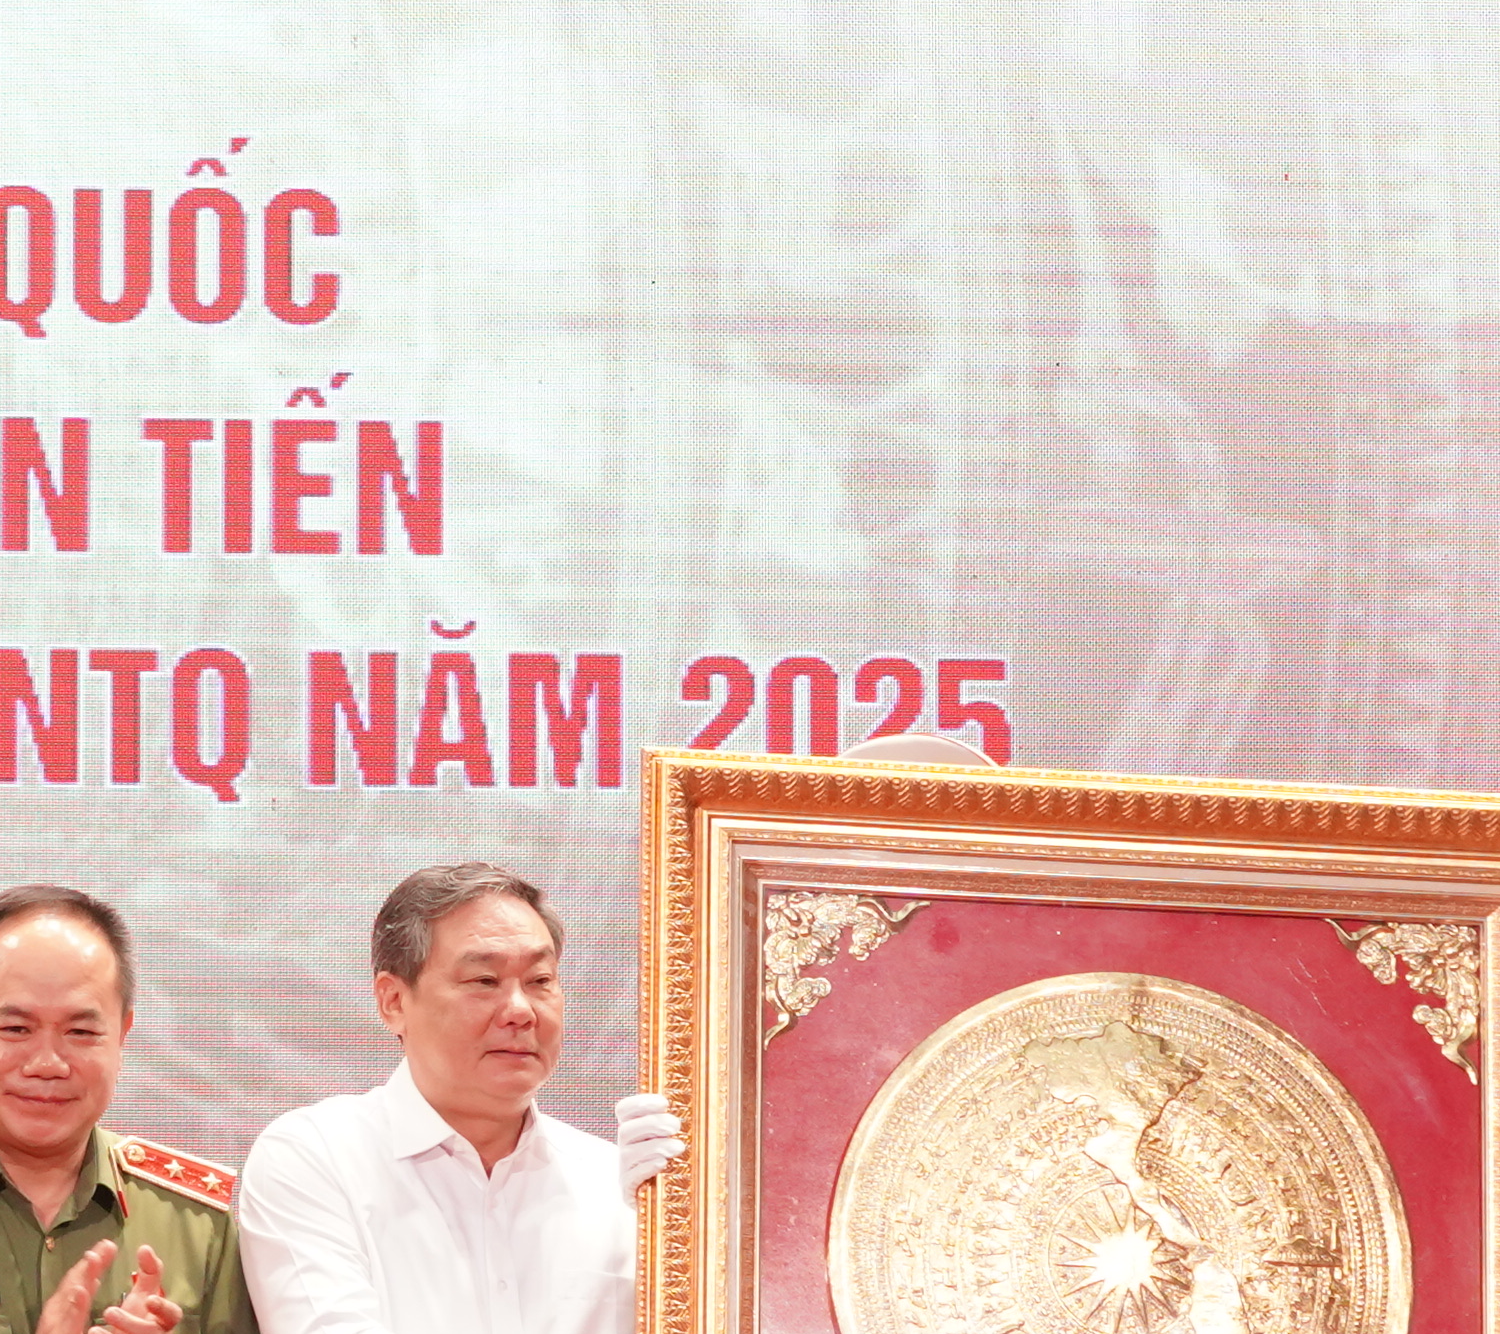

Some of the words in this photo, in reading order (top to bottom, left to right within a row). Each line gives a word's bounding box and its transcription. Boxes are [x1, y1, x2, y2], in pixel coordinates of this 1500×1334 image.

[145, 375, 441, 554] TIẾN
[310, 626, 621, 787] NĂM
[682, 655, 1012, 765] 2025
